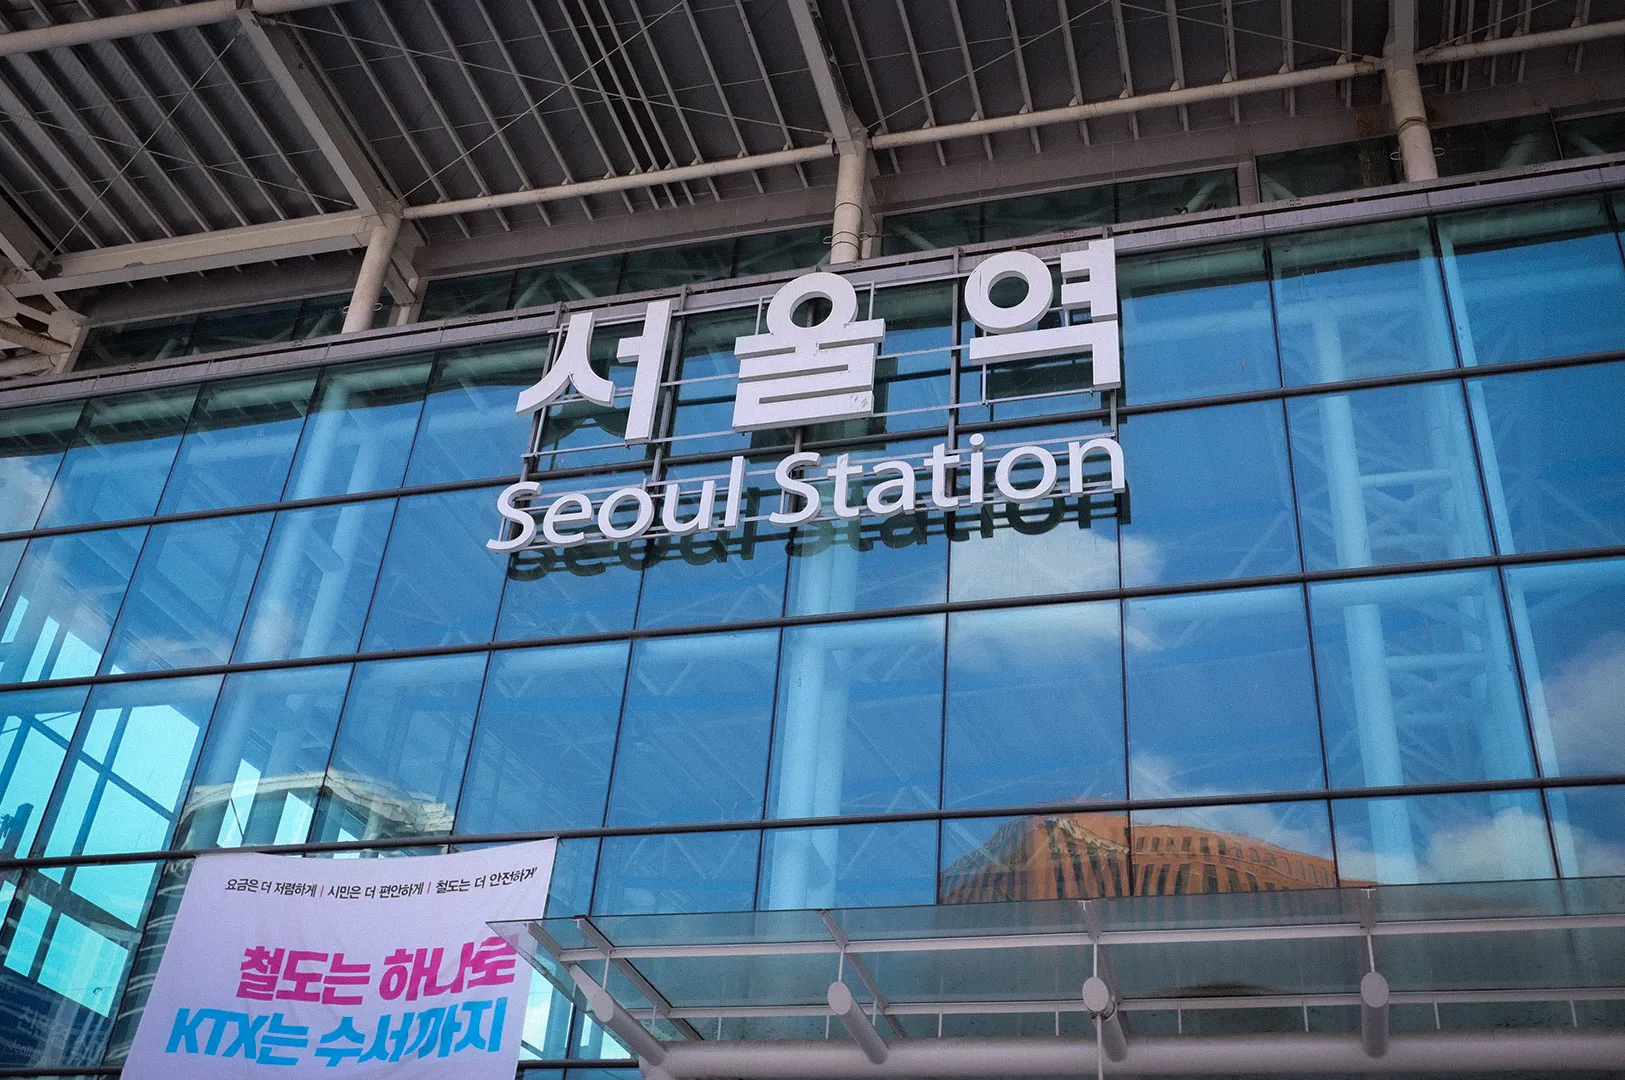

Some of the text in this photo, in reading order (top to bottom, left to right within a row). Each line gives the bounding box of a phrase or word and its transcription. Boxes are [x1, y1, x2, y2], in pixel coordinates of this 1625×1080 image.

[515, 239, 1122, 443] 서울역
[486, 433, 1126, 553] Seoul Station
[225, 878, 259, 893] 요금은
[261, 881, 272, 894] 더
[274, 882, 317, 898] 저렴하게
[328, 885, 362, 900] 시민은
[365, 886, 376, 899] 더
[379, 882, 424, 899] 편안하게
[436, 879, 471, 894] 철도는
[475, 875, 487, 889] 더
[236, 934, 520, 1006] 철도는 하나로
[165, 996, 508, 1067] KTX는 수서까지
